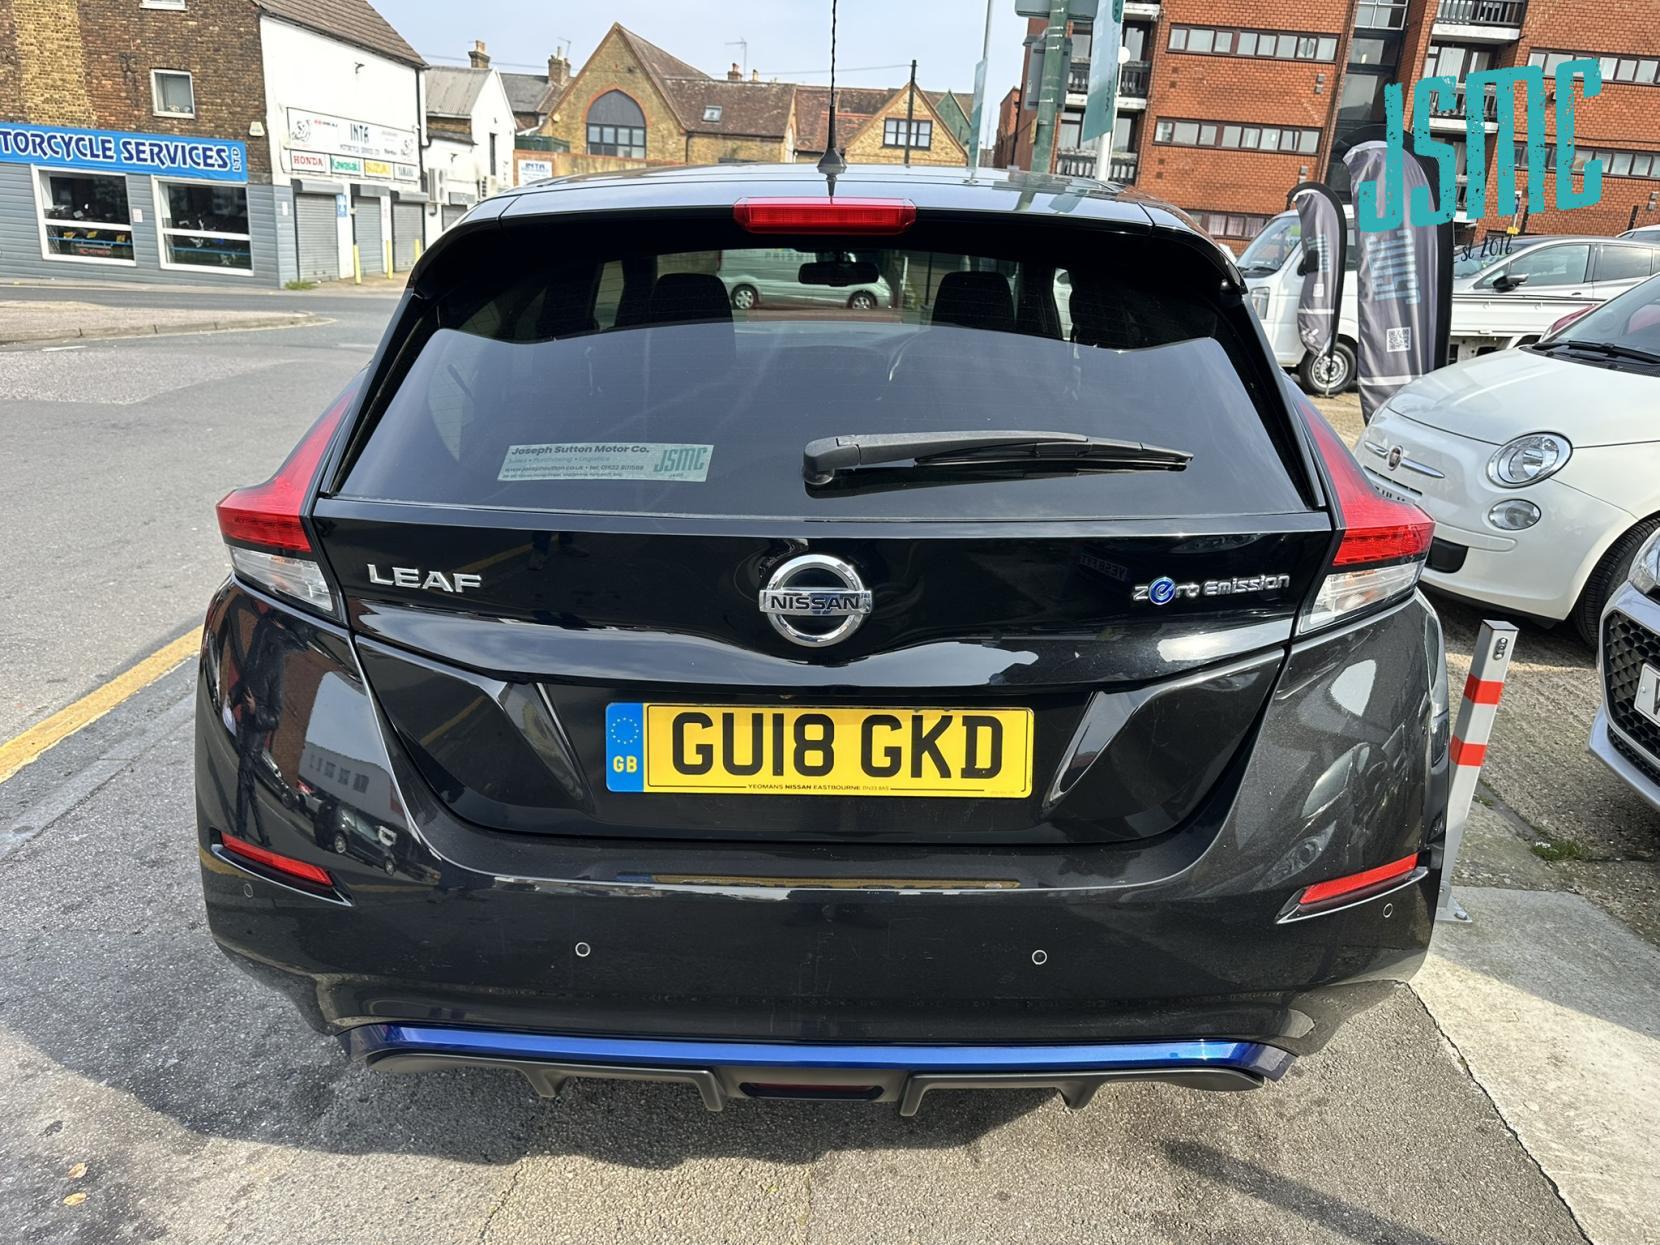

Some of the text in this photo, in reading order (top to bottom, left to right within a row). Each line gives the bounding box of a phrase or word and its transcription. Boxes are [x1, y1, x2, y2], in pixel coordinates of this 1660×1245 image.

[0, 130, 242, 171] TORCYCLE SERVICES LTD
[293, 156, 324, 166] HONDA
[511, 444, 650, 455] Joseph Sutton Motor Co.
[653, 447, 708, 473] JSMC
[366, 563, 482, 592] LEAF
[770, 596, 859, 609] NISSAN
[672, 711, 1003, 779] GU18 GKD
[612, 755, 638, 773] GB
